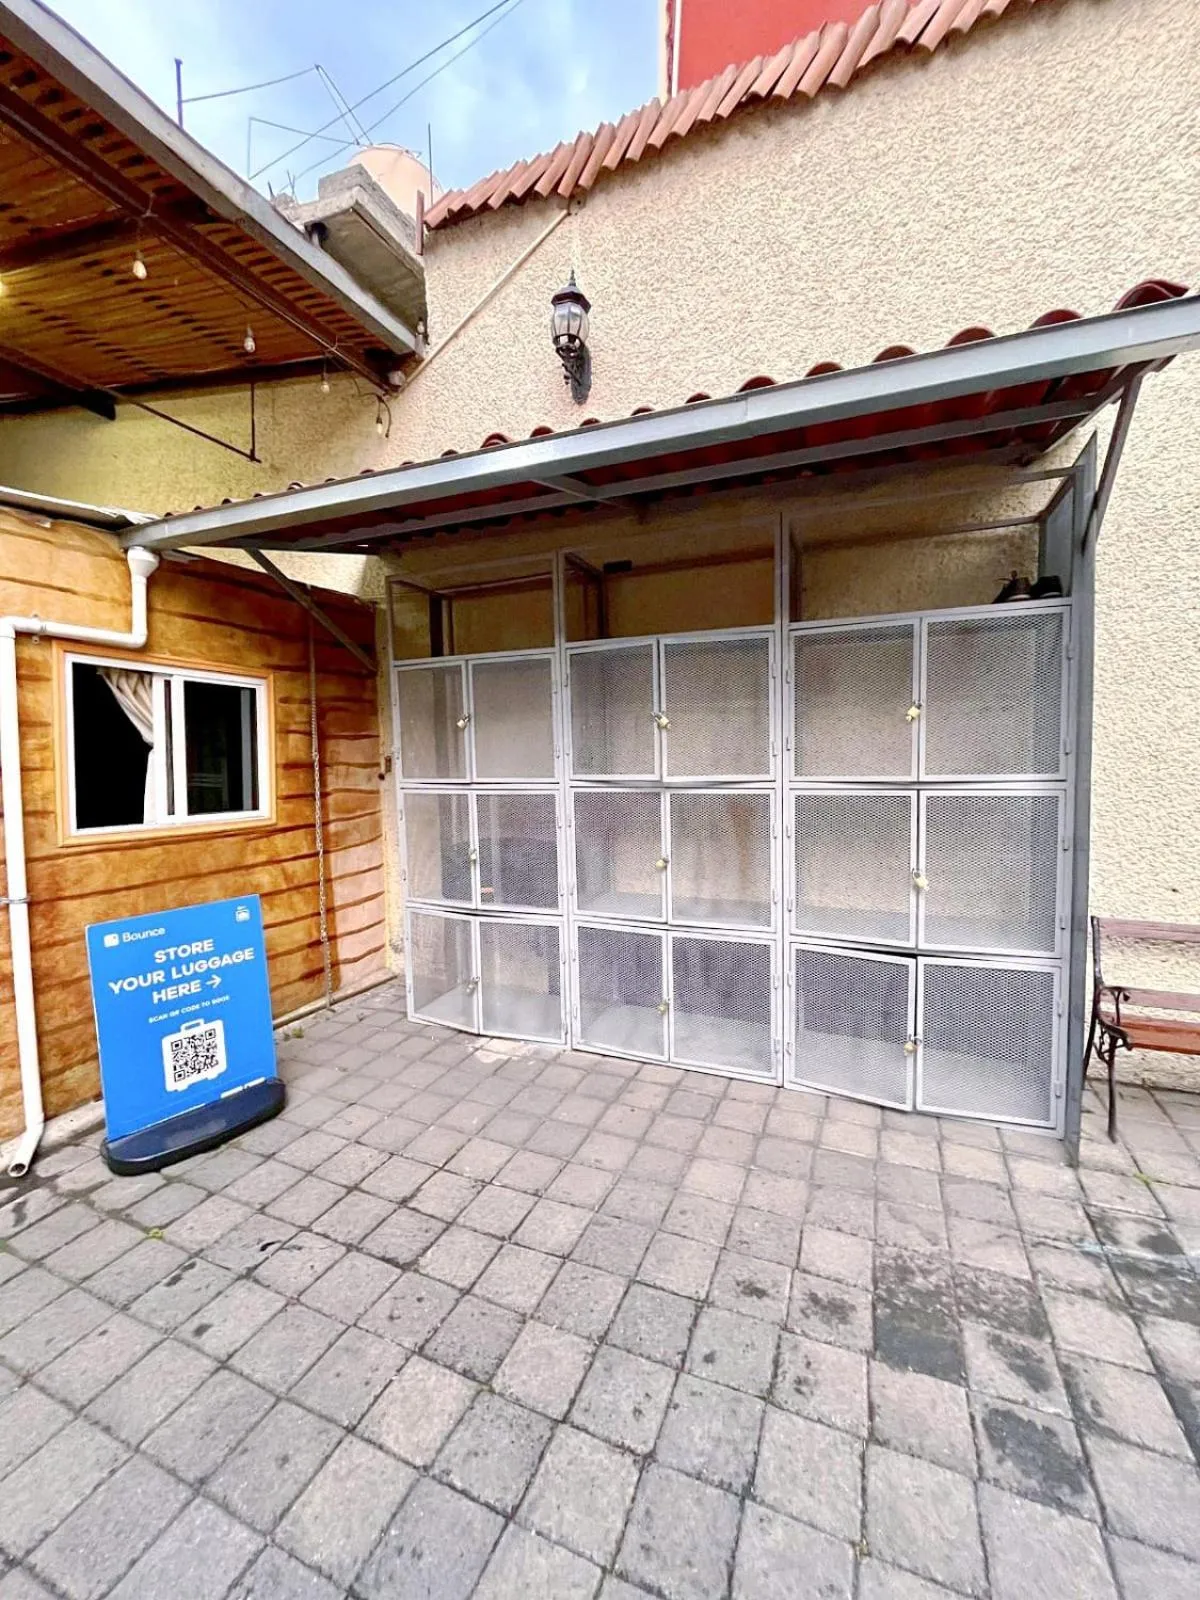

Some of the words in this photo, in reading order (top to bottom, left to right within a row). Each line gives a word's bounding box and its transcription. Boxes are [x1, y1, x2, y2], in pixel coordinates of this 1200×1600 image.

[122, 927, 166, 942] Bounce
[154, 939, 214, 963] STORE
[108, 970, 166, 994] YOUR
[171, 948, 255, 979] LUGGAGE
[152, 979, 202, 1004] HERE
[181, 1003, 200, 1014] CODE
